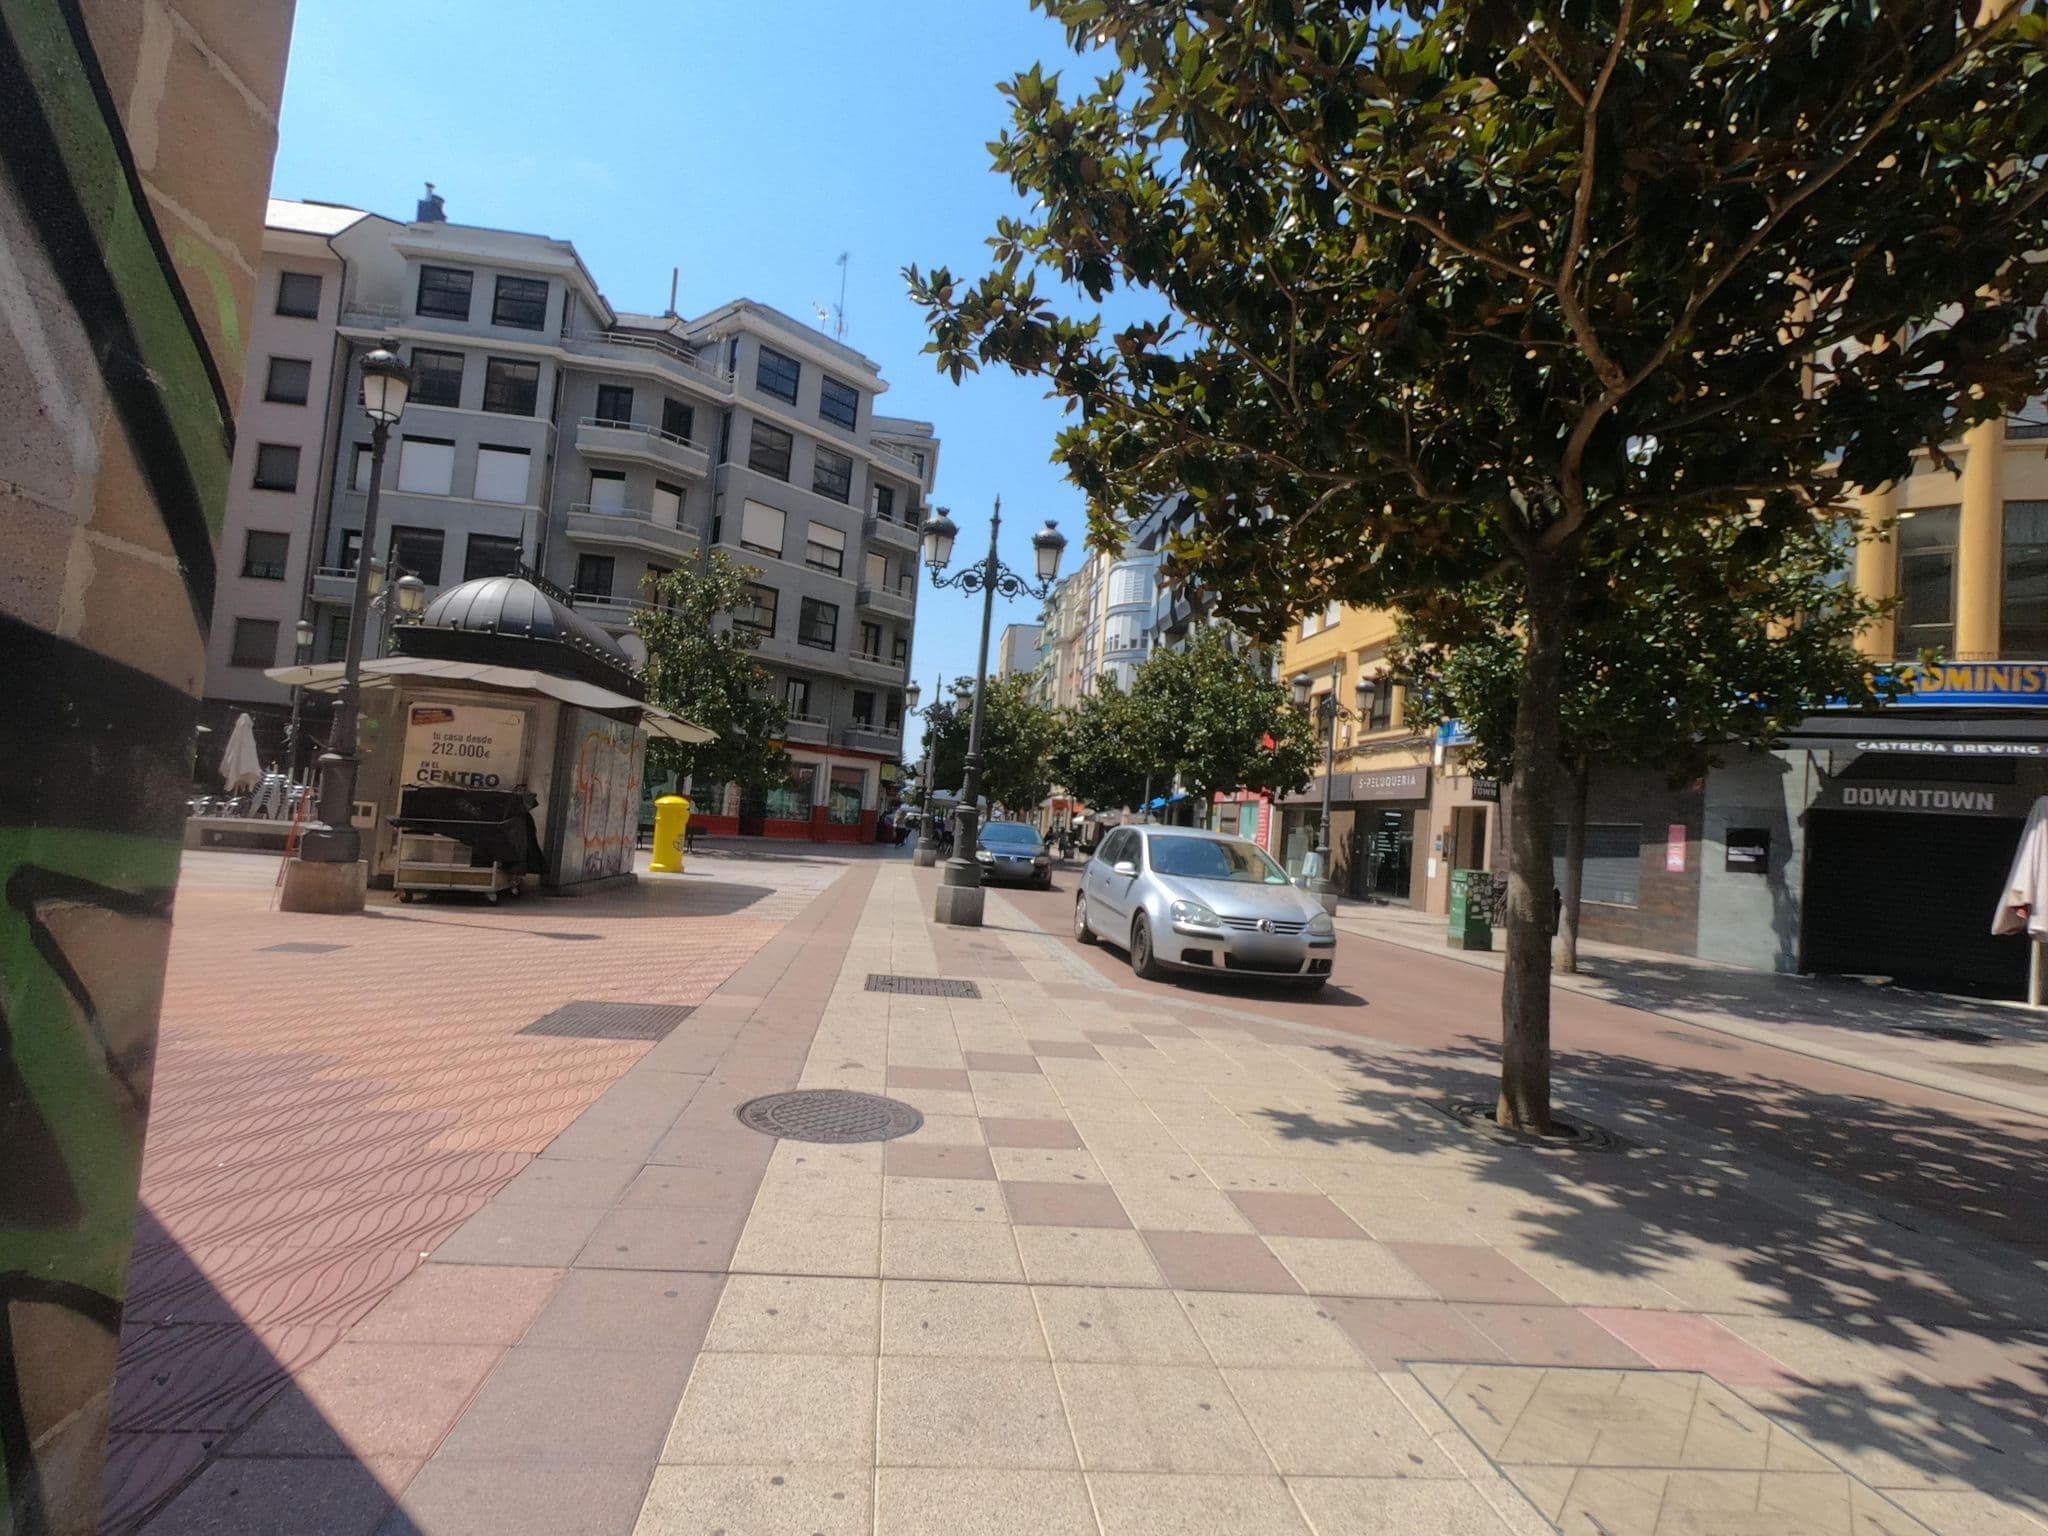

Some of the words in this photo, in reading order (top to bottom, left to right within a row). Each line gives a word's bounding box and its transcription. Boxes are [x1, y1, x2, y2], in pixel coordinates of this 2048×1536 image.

[444, 733, 463, 742] casa
[466, 733, 493, 744] desde
[431, 742, 490, 758] 212.000€
[1855, 741, 1947, 753] CASTREÑA
[1952, 743, 2042, 755] BREWING
[416, 769, 500, 787] CENTRO
[1843, 787, 1994, 810] DOWNTOWN
